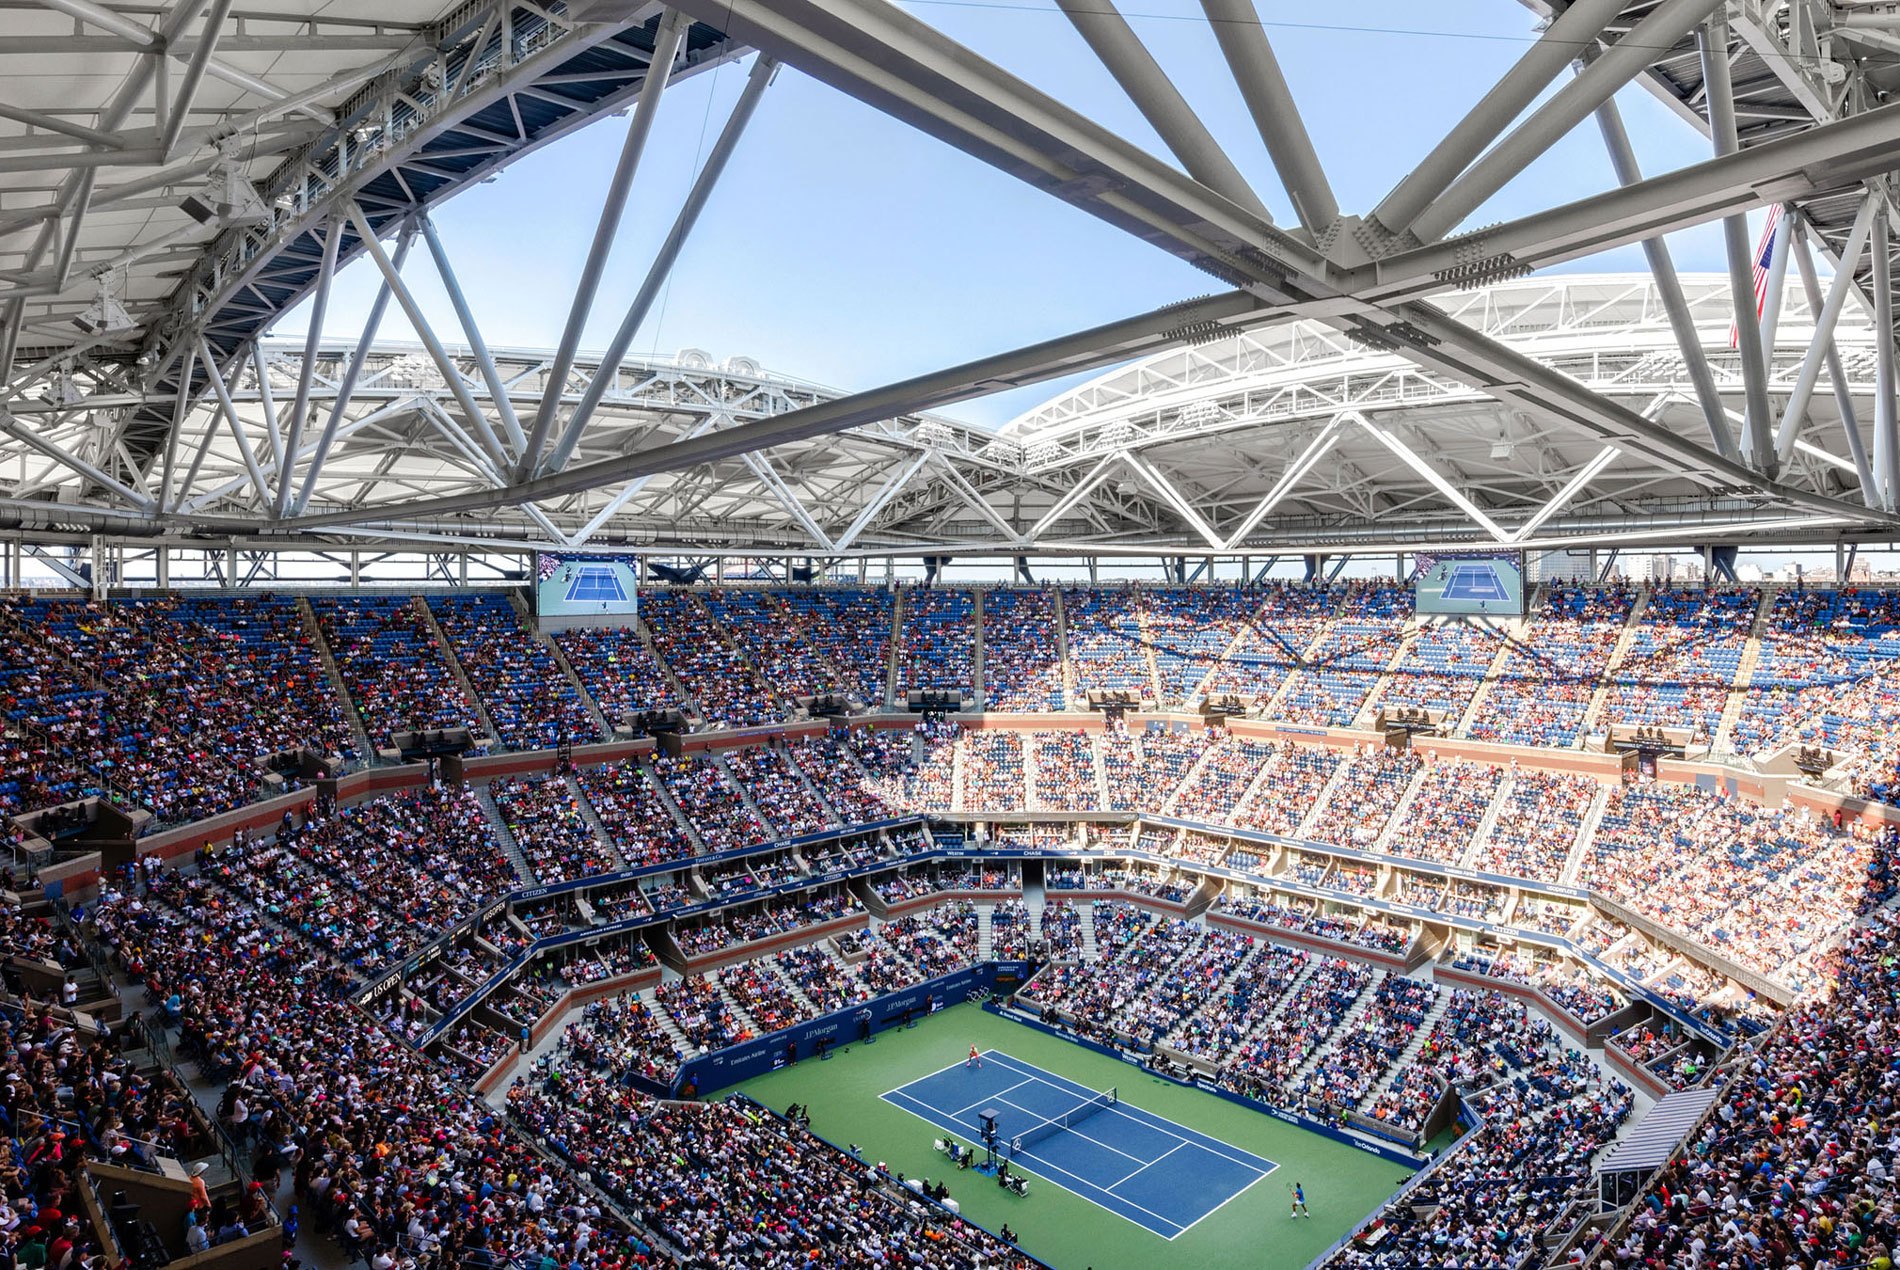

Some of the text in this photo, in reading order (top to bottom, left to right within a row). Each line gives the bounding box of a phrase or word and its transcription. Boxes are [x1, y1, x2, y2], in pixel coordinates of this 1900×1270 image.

[522, 887, 548, 898] CITIZEN
[492, 901, 506, 916] OPEN
[580, 924, 623, 936] AMERICAN EXPRESS
[1492, 925, 1519, 935] CITIZEN
[373, 970, 401, 997] US OPEN
[421, 1028, 434, 1046] ATP
